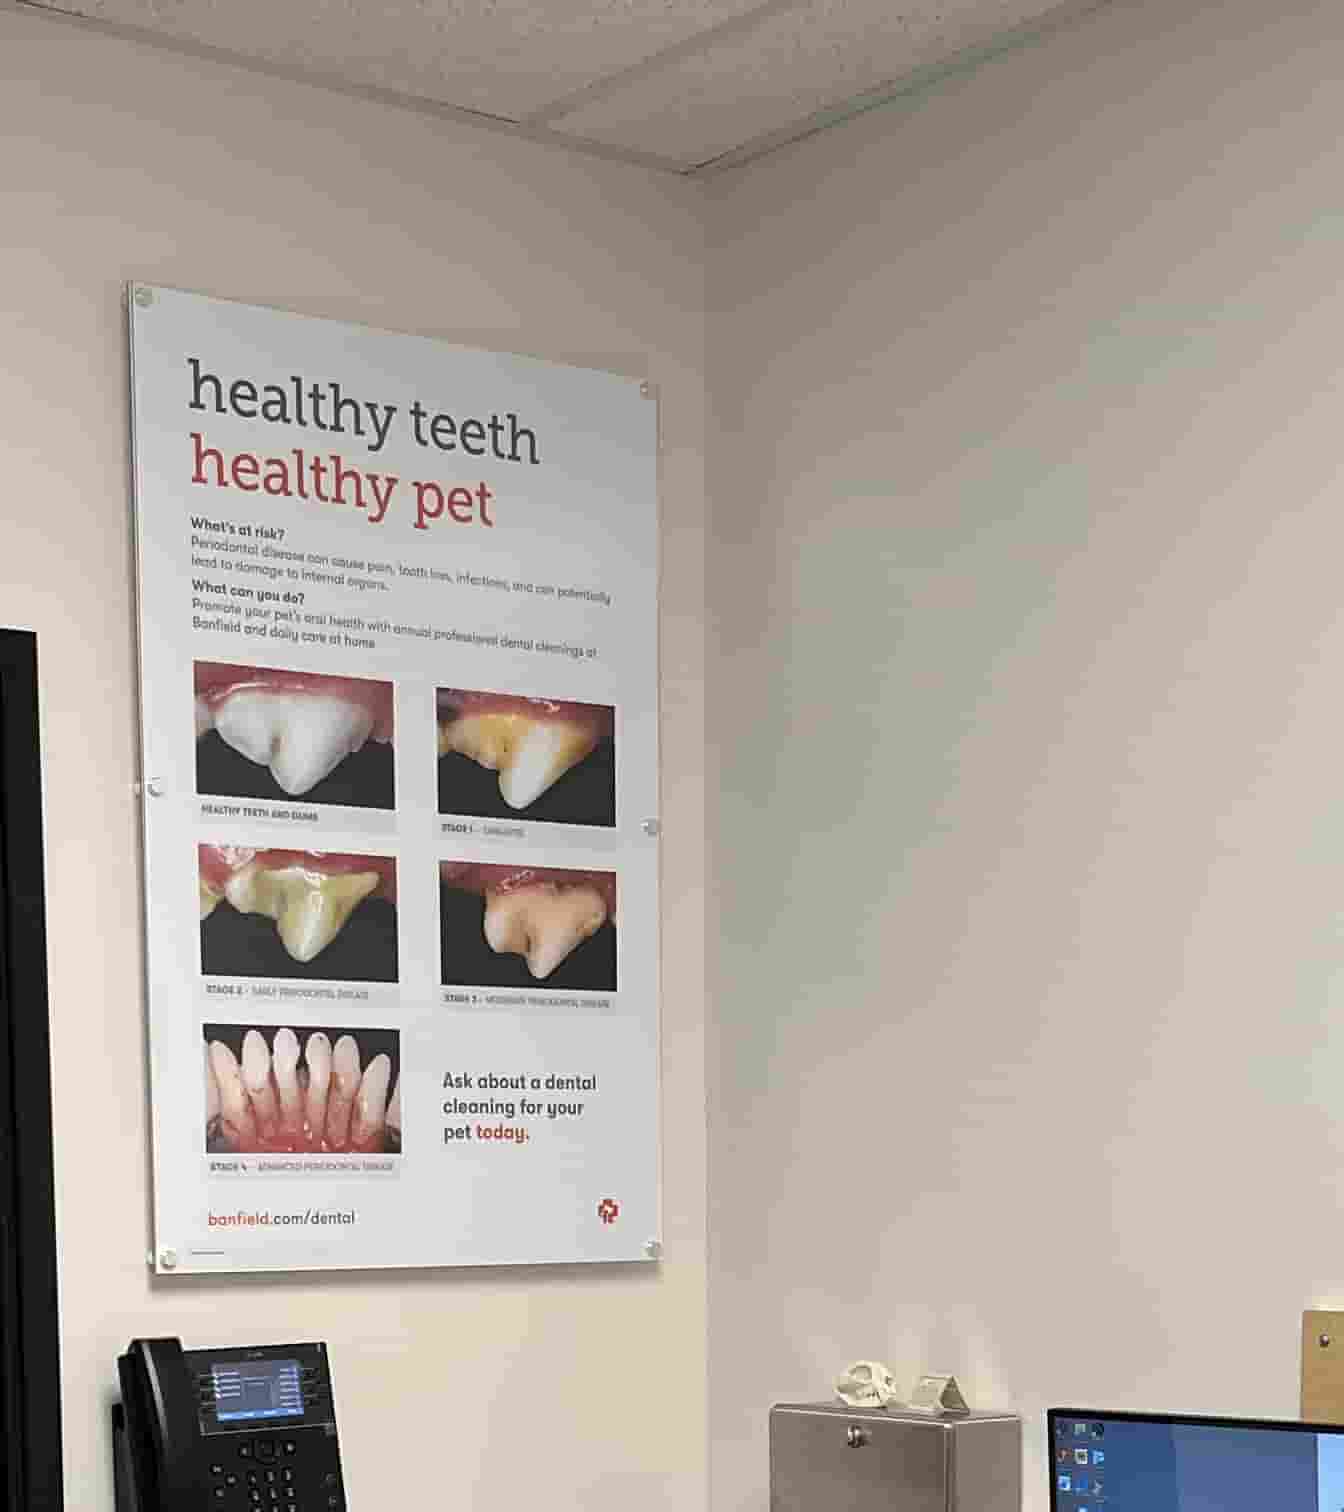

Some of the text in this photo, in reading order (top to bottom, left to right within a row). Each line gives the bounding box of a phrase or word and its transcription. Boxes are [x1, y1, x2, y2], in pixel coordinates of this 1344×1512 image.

[188, 357, 539, 464] healthy teeth
[190, 433, 494, 529] healthy pet
[191, 517, 285, 541] What's at risk?
[191, 536, 259, 555] Periodontal
[191, 553, 217, 568] lead
[221, 558, 233, 570] to
[235, 561, 284, 580] damage
[287, 567, 299, 580] to
[302, 570, 344, 585] internal
[192, 579, 305, 605] What can you do?
[192, 598, 241, 616] Promote
[245, 605, 271, 619] your
[274, 608, 301, 624] pet's
[329, 615, 364, 631] health
[368, 619, 390, 633] with
[192, 616, 240, 634] Banfield
[244, 623, 266, 637] and
[270, 626, 298, 644] daily
[328, 633, 341, 645] at
[443, 1072, 596, 1091] Ask about a dental
[443, 1098, 584, 1119] cleaning for your
[444, 1123, 530, 1144] pet today.
[208, 1208, 355, 1226] banfield.com/dental
